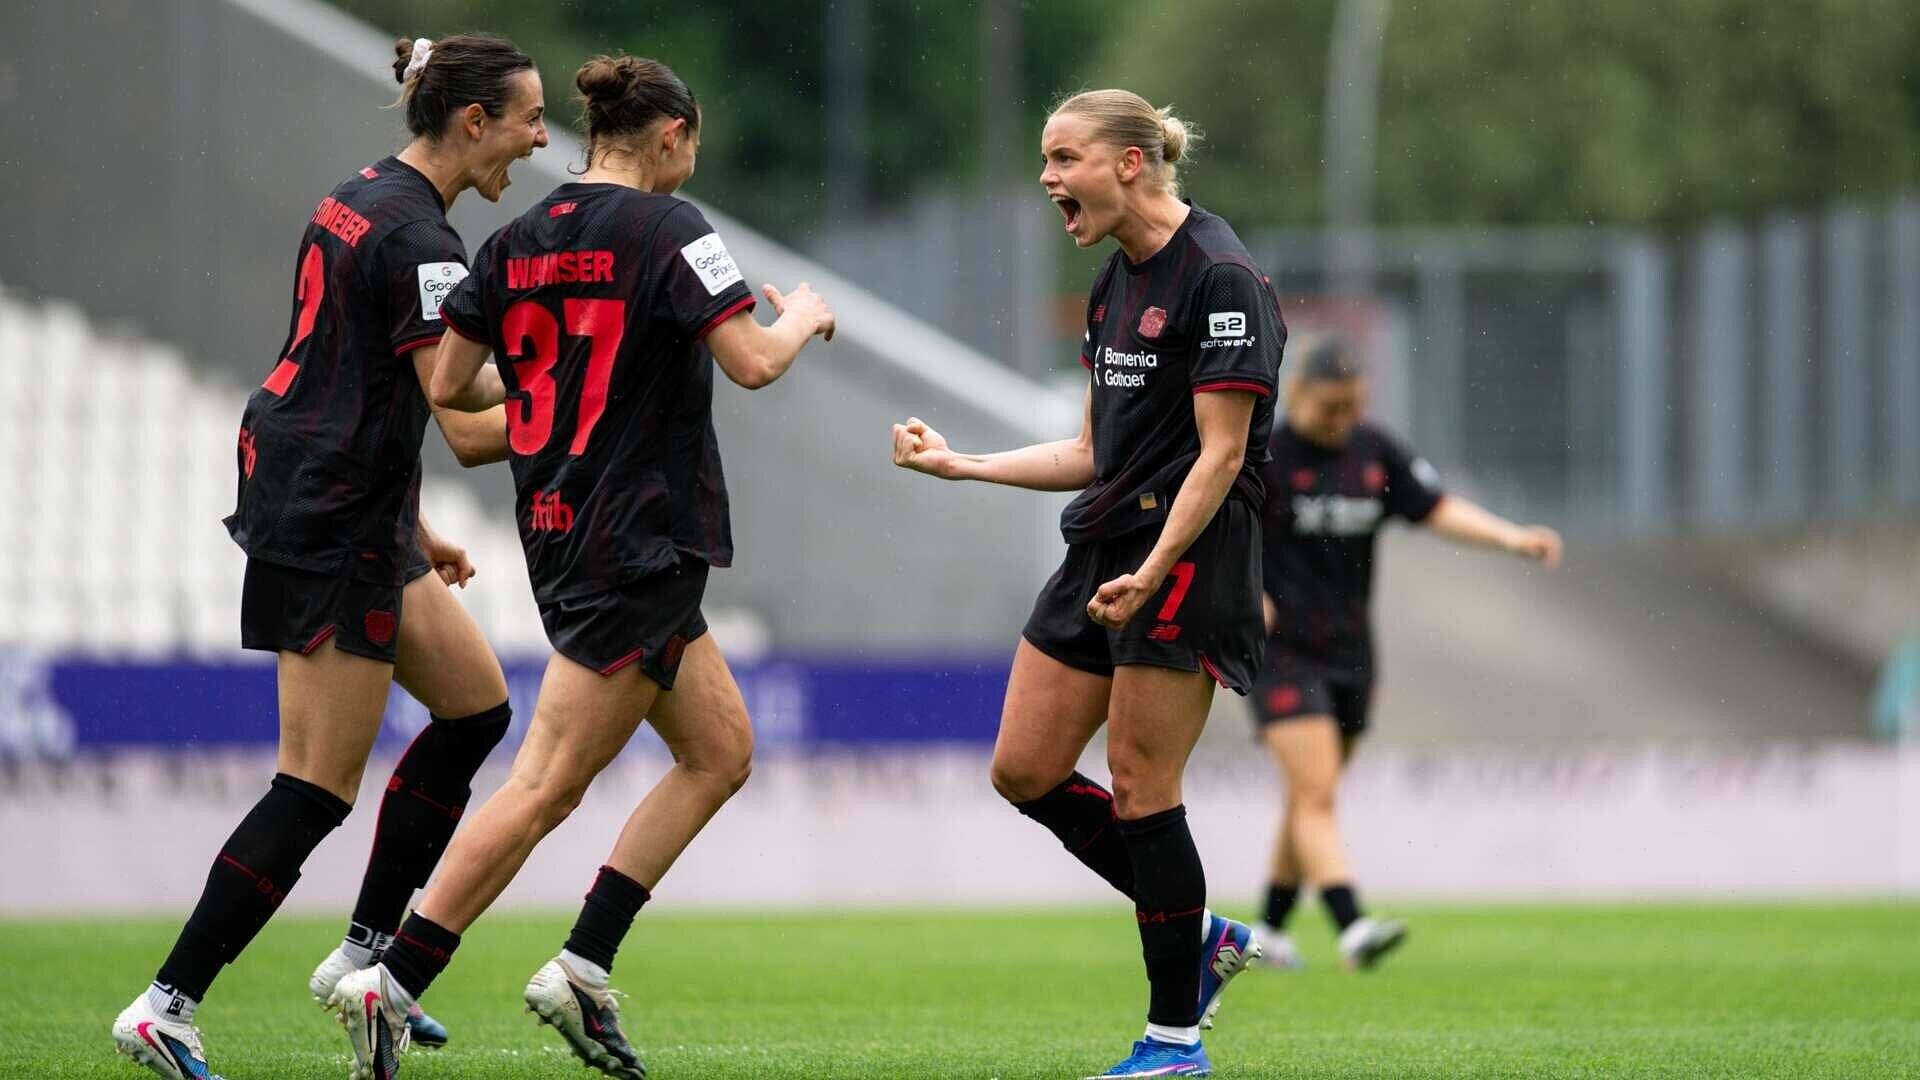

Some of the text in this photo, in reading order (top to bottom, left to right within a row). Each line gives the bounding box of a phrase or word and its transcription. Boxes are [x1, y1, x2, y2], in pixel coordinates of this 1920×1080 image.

[506, 250, 615, 289] WAMSER
[262, 243, 325, 397] 2
[1213, 317, 1243, 331] s2
[502, 298, 625, 456] 37
[1157, 561, 1196, 622] 7
